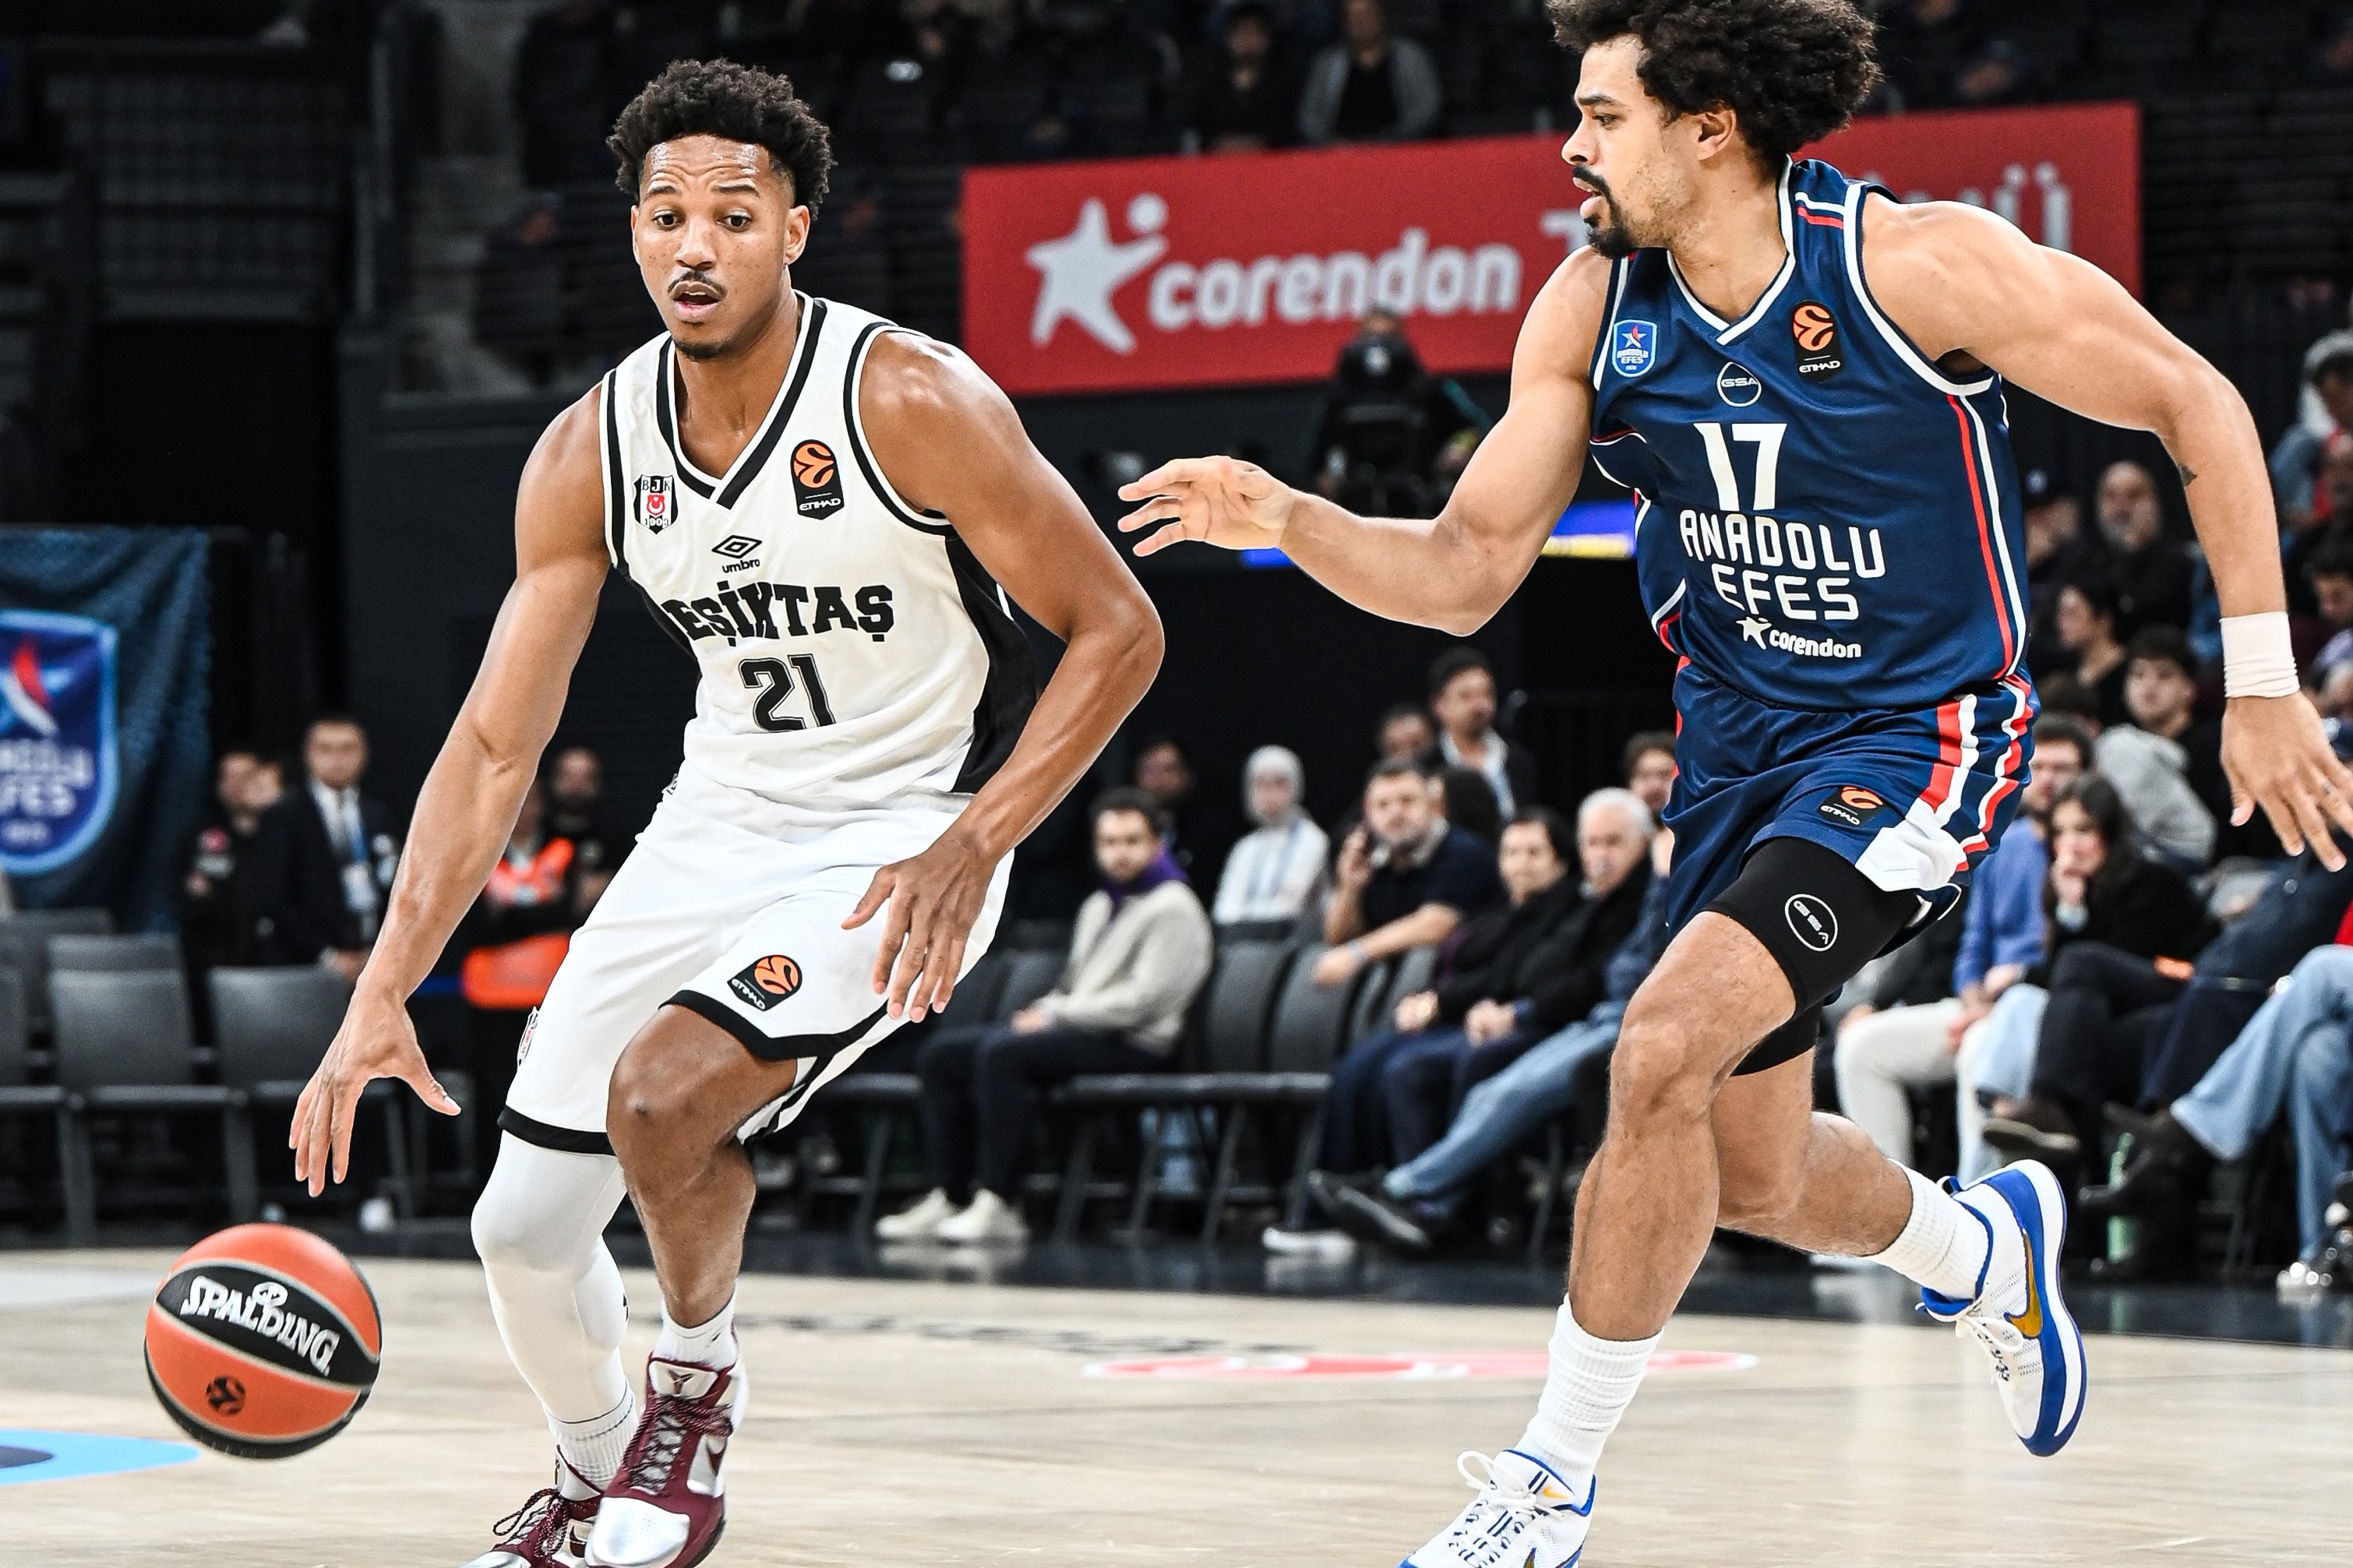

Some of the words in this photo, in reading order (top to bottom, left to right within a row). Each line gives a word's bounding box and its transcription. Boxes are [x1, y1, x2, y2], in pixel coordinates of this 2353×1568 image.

[1149, 227, 1521, 330] corendon
[1621, 356, 1644, 365] EFES
[1798, 361, 1841, 373] ETIHAD
[1721, 377, 1758, 388] GSA
[1693, 422, 1787, 511] 17
[799, 498, 841, 511] ETIHAD
[1680, 509, 1886, 578] ANADOLU
[721, 558, 760, 573] umbro
[1711, 563, 1859, 621] EFES
[661, 580, 894, 647] EŞİKTAŞ
[1769, 629, 1861, 658] corendon
[738, 654, 837, 733] 21
[1820, 805, 1861, 826] ETIHAD
[731, 978, 766, 1010] ETIHAD
[180, 1275, 341, 1377] SPALDING
